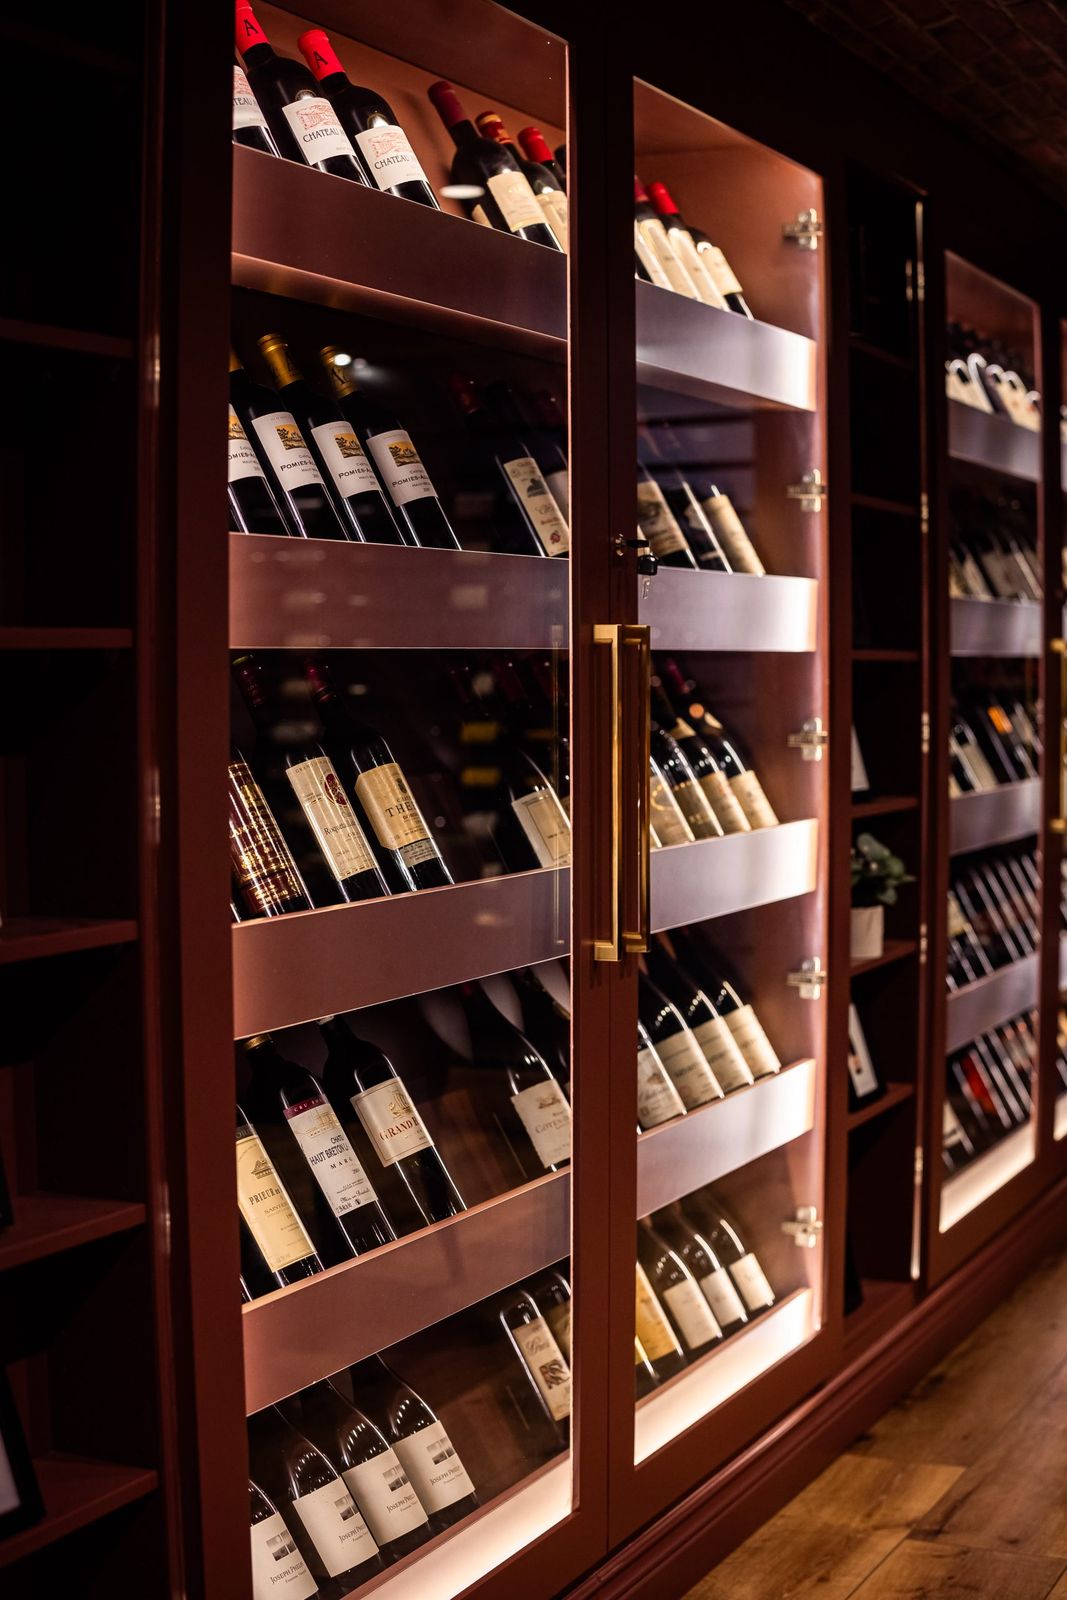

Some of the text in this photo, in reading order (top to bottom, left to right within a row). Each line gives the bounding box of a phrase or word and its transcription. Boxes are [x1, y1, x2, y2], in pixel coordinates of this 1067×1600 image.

[244, 19, 258, 36] A
[314, 51, 328, 69] A
[270, 1569, 291, 1585] JOSEPH
